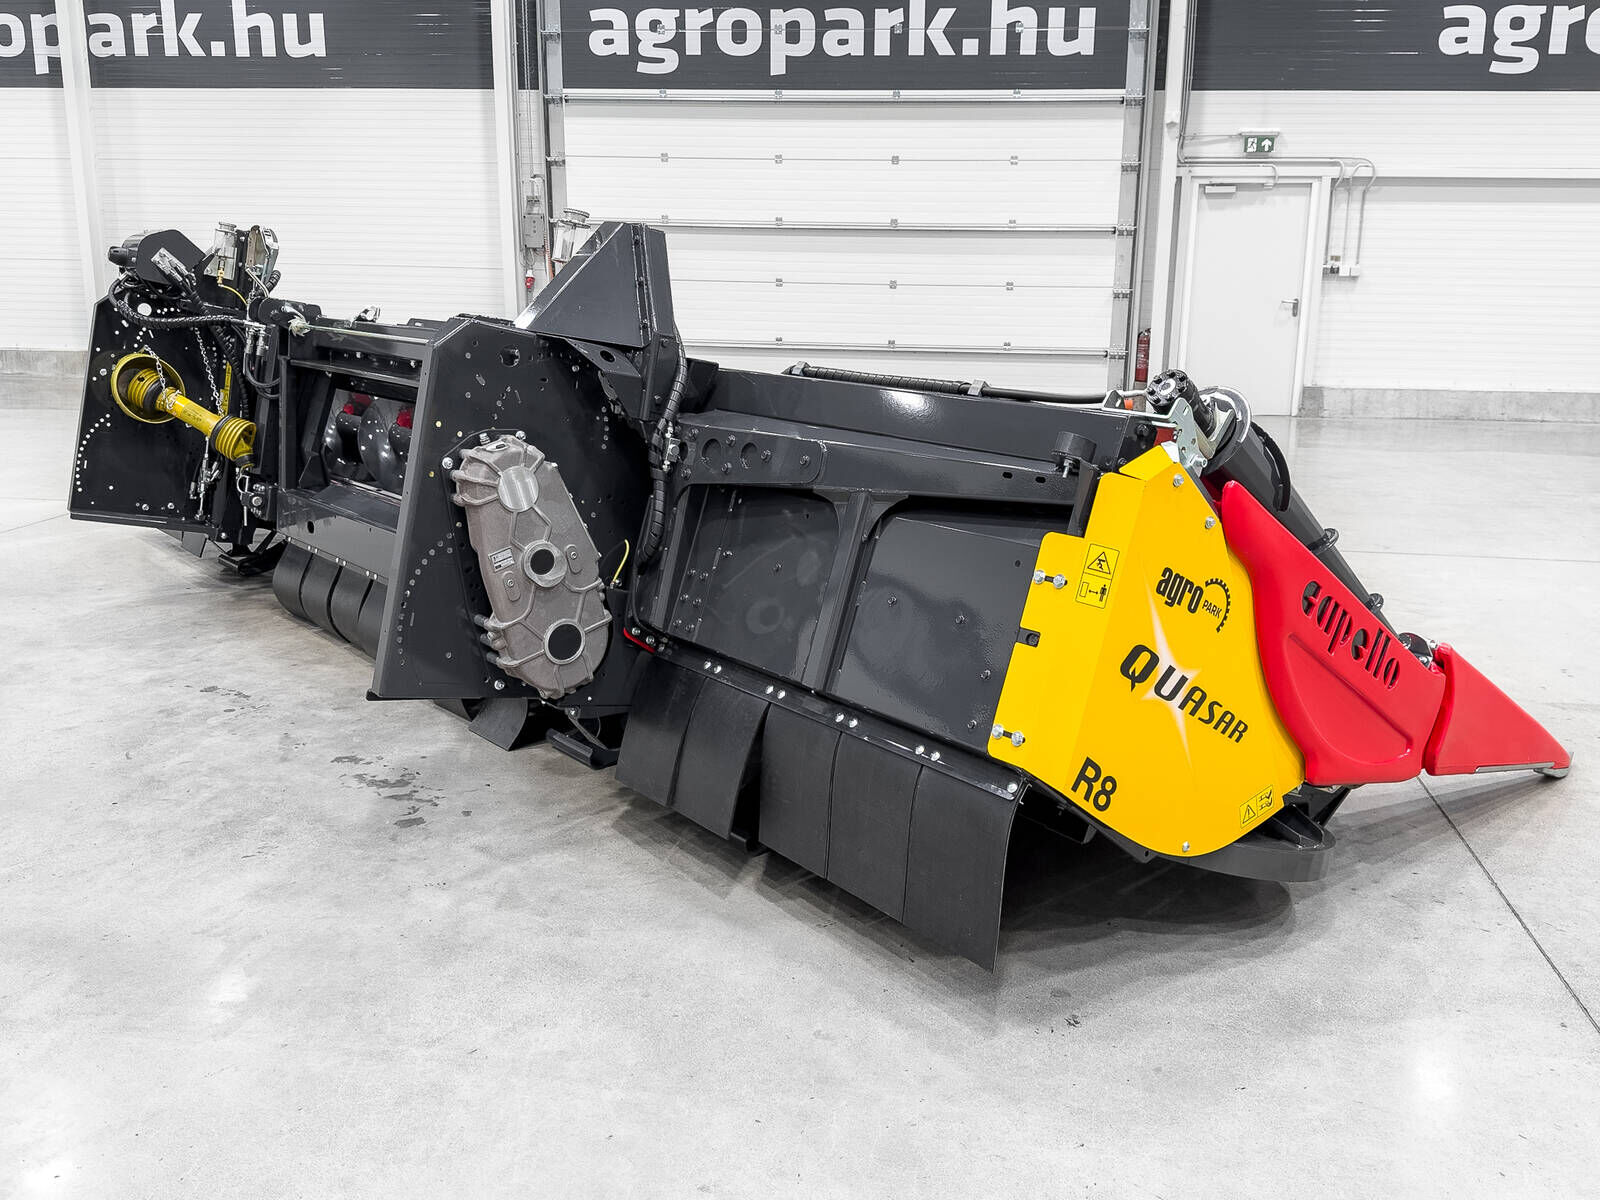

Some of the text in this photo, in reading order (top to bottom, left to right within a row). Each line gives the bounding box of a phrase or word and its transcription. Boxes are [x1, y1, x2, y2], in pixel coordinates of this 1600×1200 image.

[588, 0, 1096, 76] agropark.hu
[1156, 567, 1222, 619] agro PARK
[1120, 644, 1249, 743] QUASAR
[1071, 756, 1118, 812] R8
